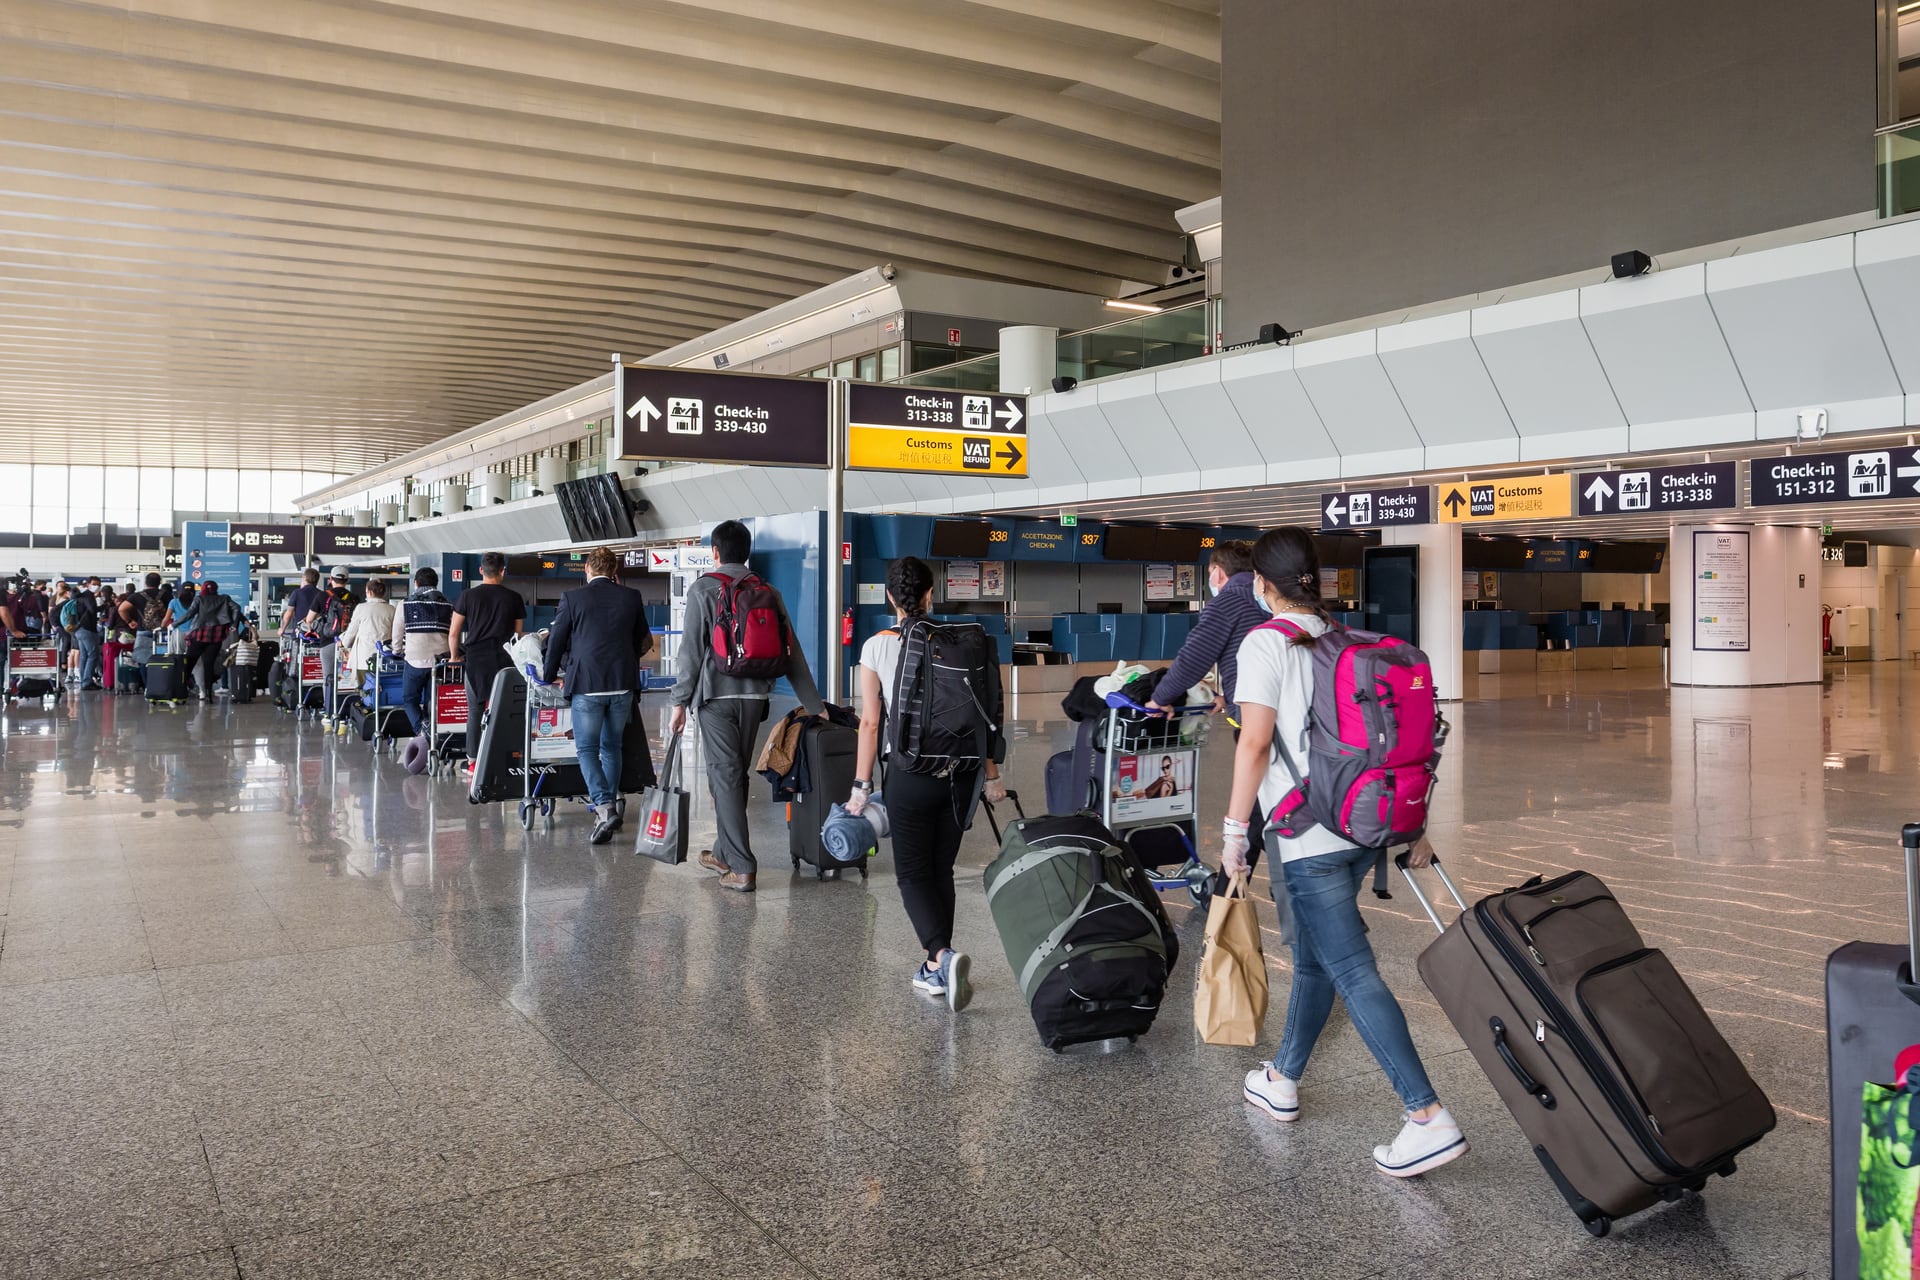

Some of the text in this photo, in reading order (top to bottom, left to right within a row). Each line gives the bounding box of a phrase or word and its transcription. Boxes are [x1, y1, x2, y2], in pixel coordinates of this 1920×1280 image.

[905, 395, 953, 410] Check-in
[714, 404, 769, 420] Check-in
[907, 409, 953, 423] 313-338
[714, 420, 767, 434] 339-430
[906, 437, 953, 450] Customs
[963, 442, 991, 457] VAT
[963, 456, 991, 464] REFUND
[1771, 462, 1835, 479] Check-in
[1661, 472, 1717, 488] Check-in
[1498, 486, 1543, 498] Customs
[1775, 480, 1835, 496] 151-312
[1378, 494, 1417, 507] Check-in
[1471, 489, 1494, 503] VAT
[1661, 488, 1713, 503] 313-338
[1378, 507, 1415, 519] 339-430
[1471, 504, 1494, 512] REFUND
[989, 530, 1008, 542] 338
[1021, 532, 1064, 541] ACCETTAZIONE
[1081, 534, 1099, 545] 337
[1830, 548, 1843, 560] 326
